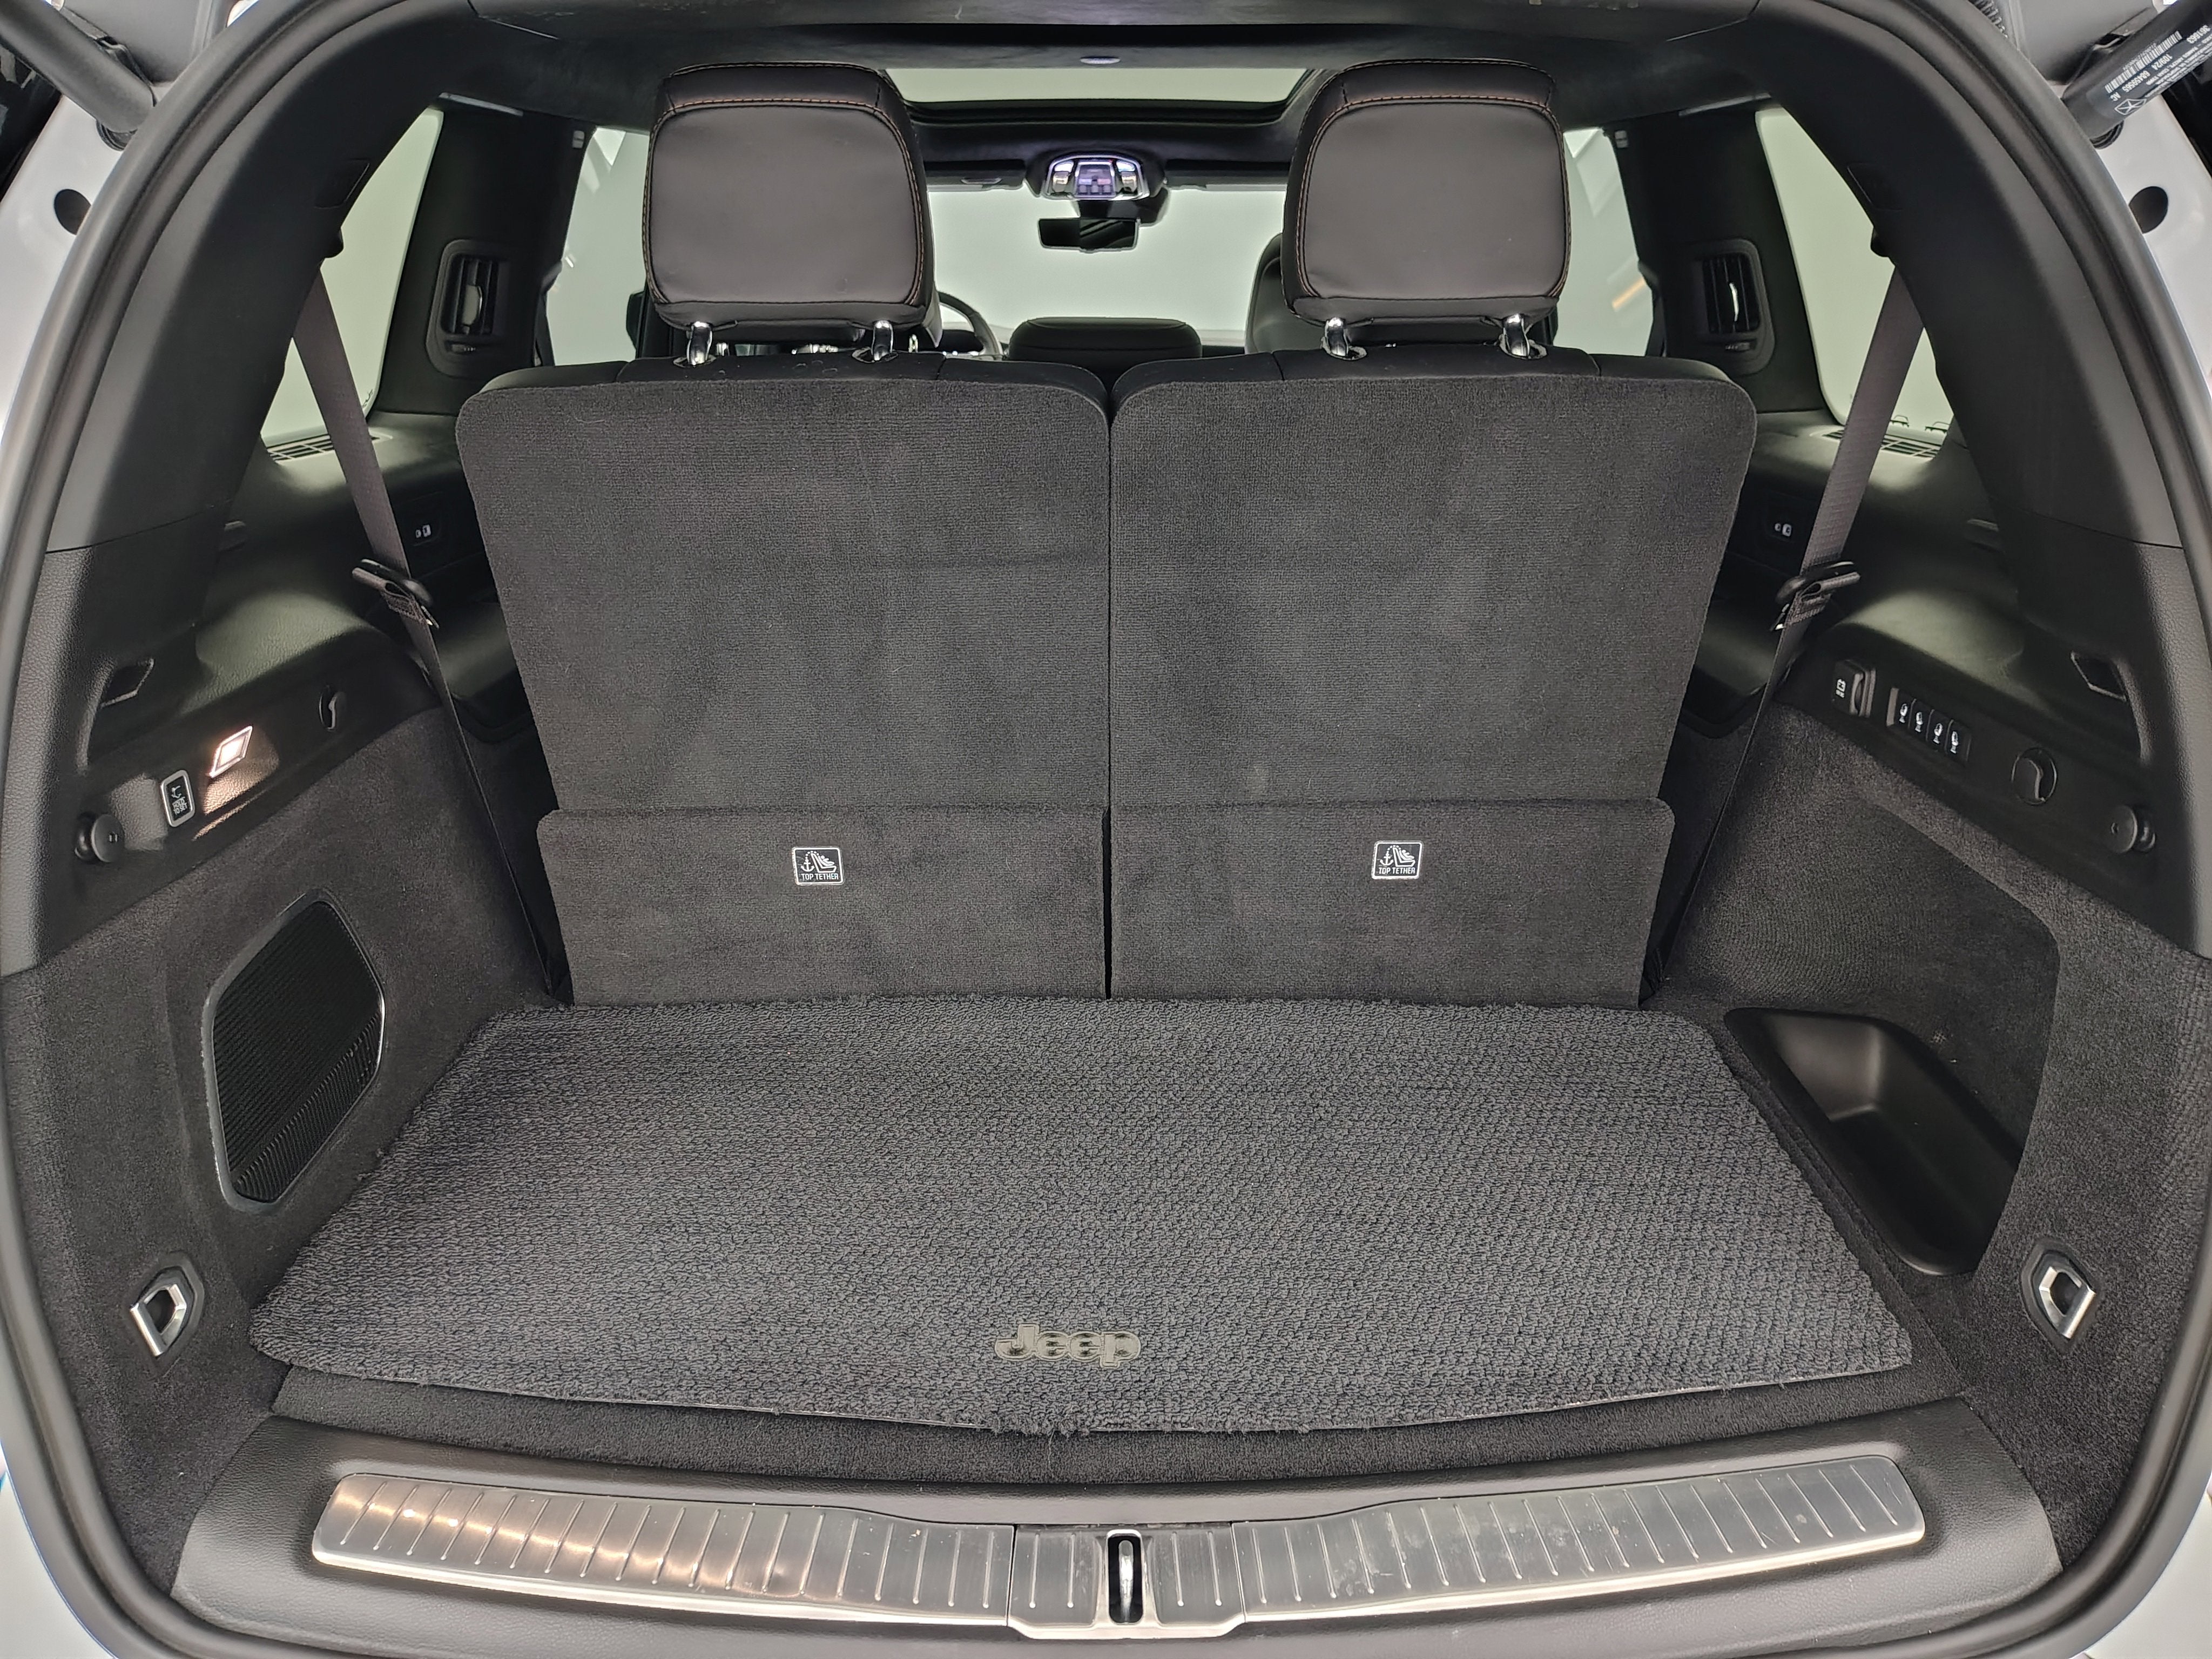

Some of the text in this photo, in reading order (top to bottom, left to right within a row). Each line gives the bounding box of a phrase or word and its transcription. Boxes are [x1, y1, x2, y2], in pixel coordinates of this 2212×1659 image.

[2122, 70, 2150, 92] 68459565
[2110, 92, 2121, 101] AC
[801, 873, 814, 881] TOP
[995, 1324, 1141, 1368] Jeep
